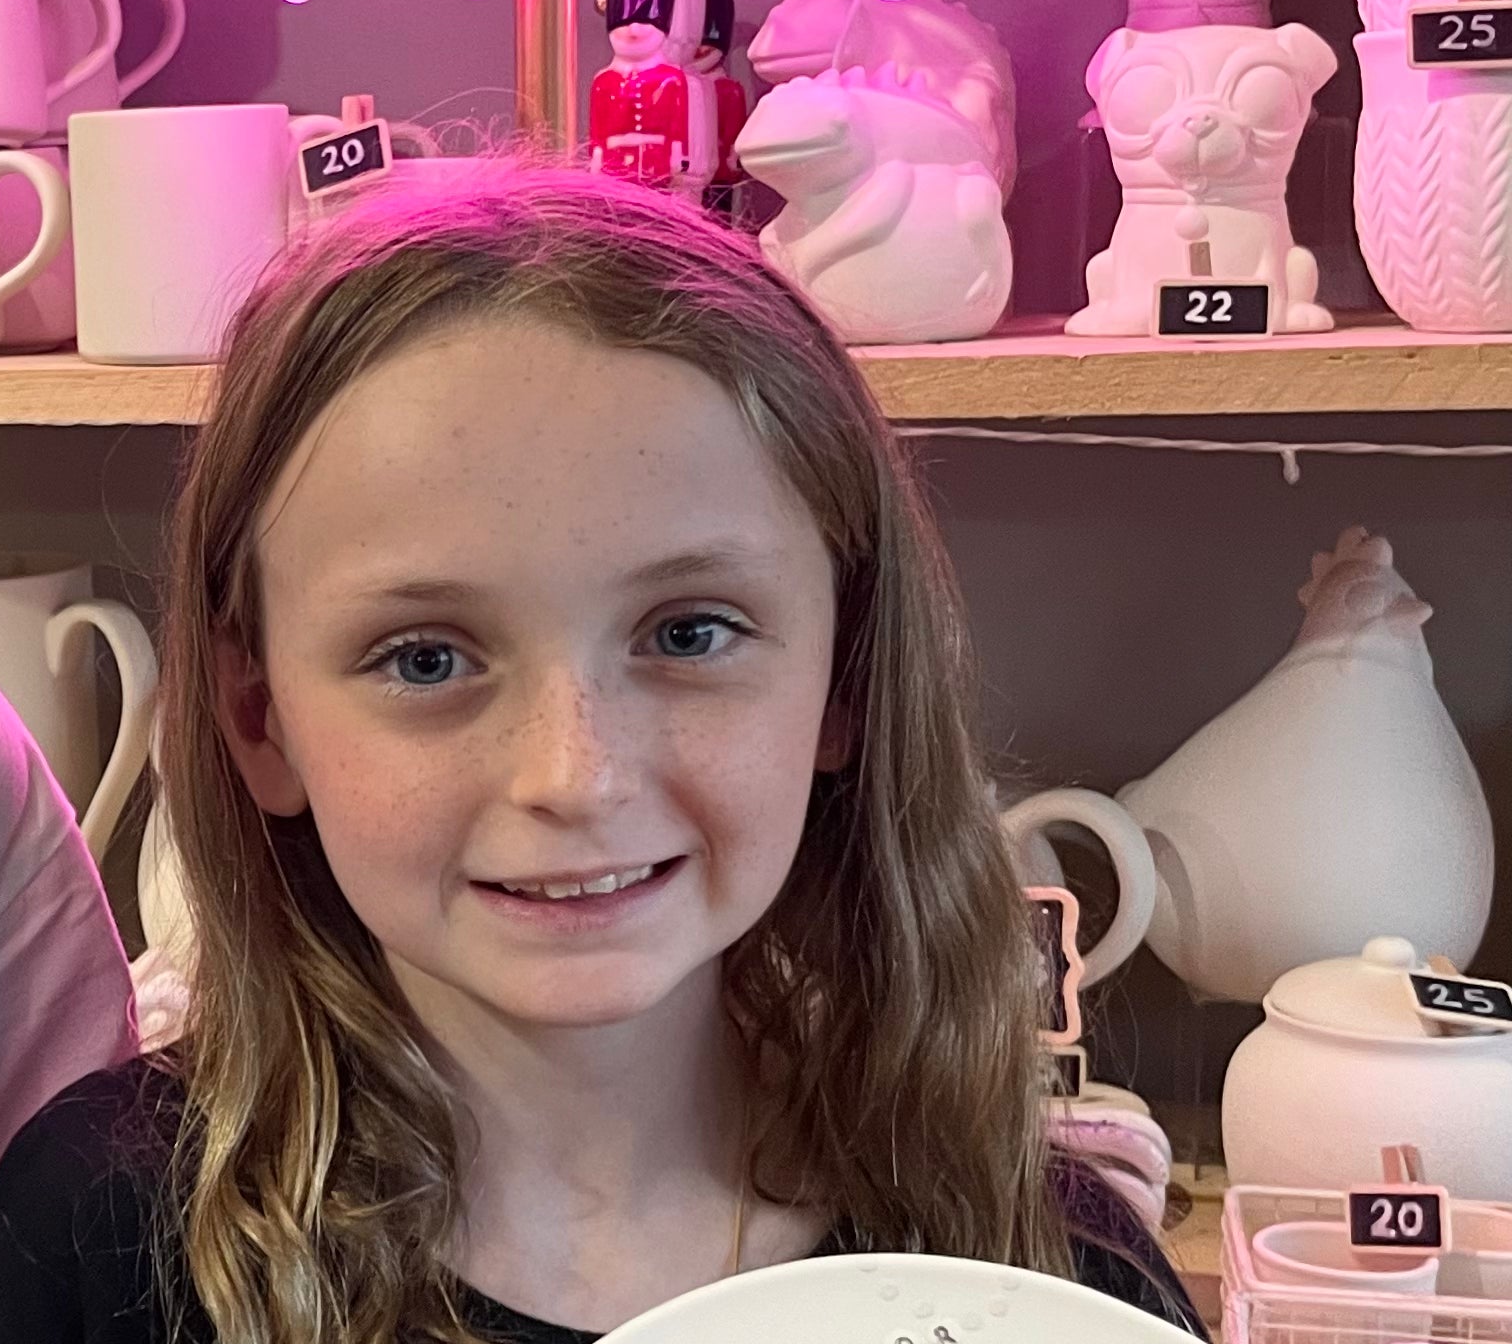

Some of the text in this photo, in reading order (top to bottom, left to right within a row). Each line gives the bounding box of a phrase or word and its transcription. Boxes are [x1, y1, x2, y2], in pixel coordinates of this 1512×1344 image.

[1438, 14, 1496, 50] 25
[321, 139, 365, 175] 20
[1184, 290, 1232, 323] 22
[1428, 983, 1495, 1014] 25
[1370, 1198, 1423, 1238] 20
